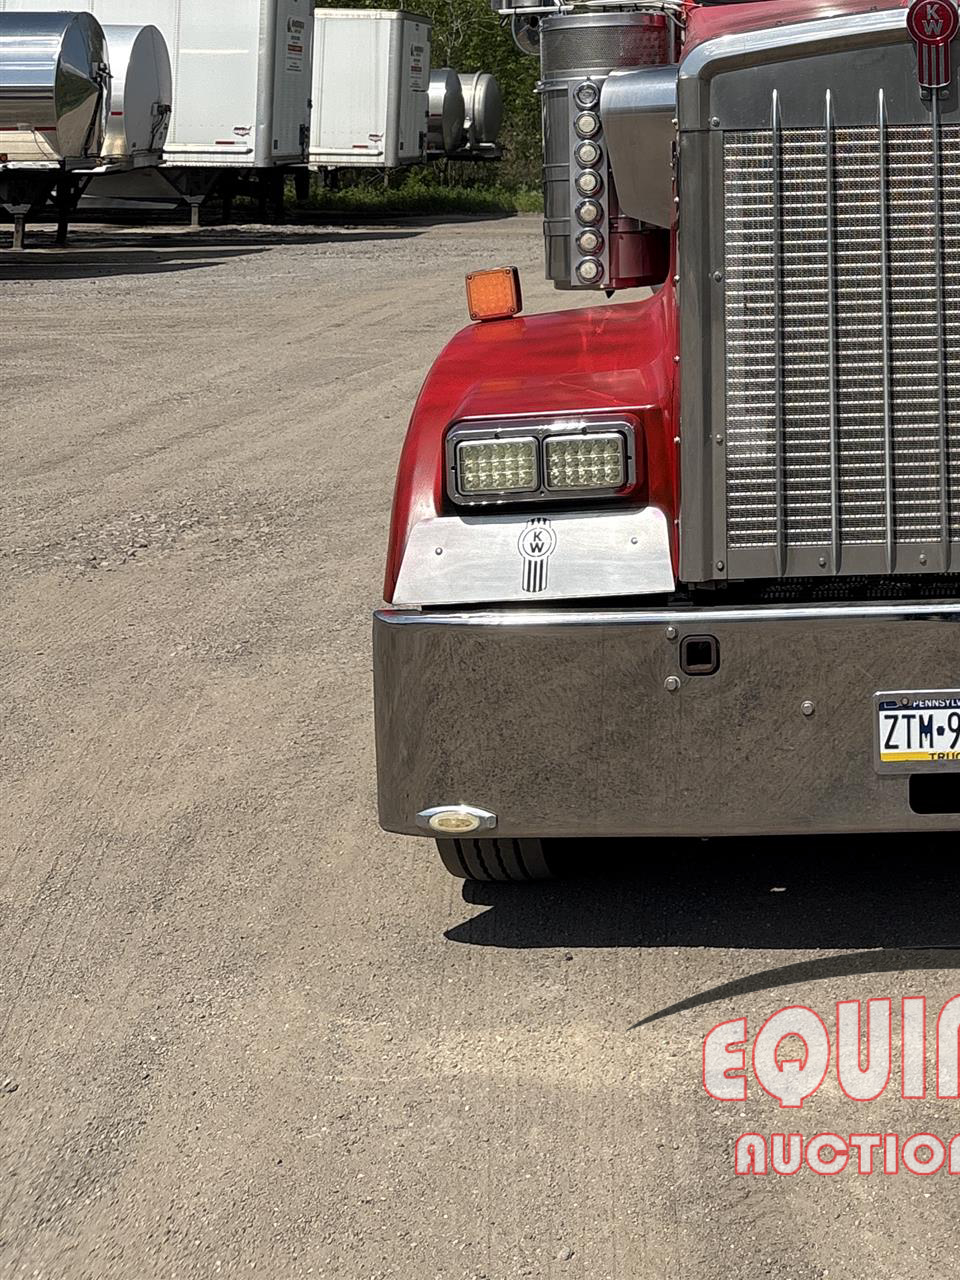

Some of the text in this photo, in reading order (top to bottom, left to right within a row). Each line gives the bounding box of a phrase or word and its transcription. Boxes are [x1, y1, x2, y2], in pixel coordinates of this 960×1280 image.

[926, 4, 940, 20] K
[922, 19, 944, 36] W
[533, 531, 543, 542] K
[529, 541, 545, 553] W
